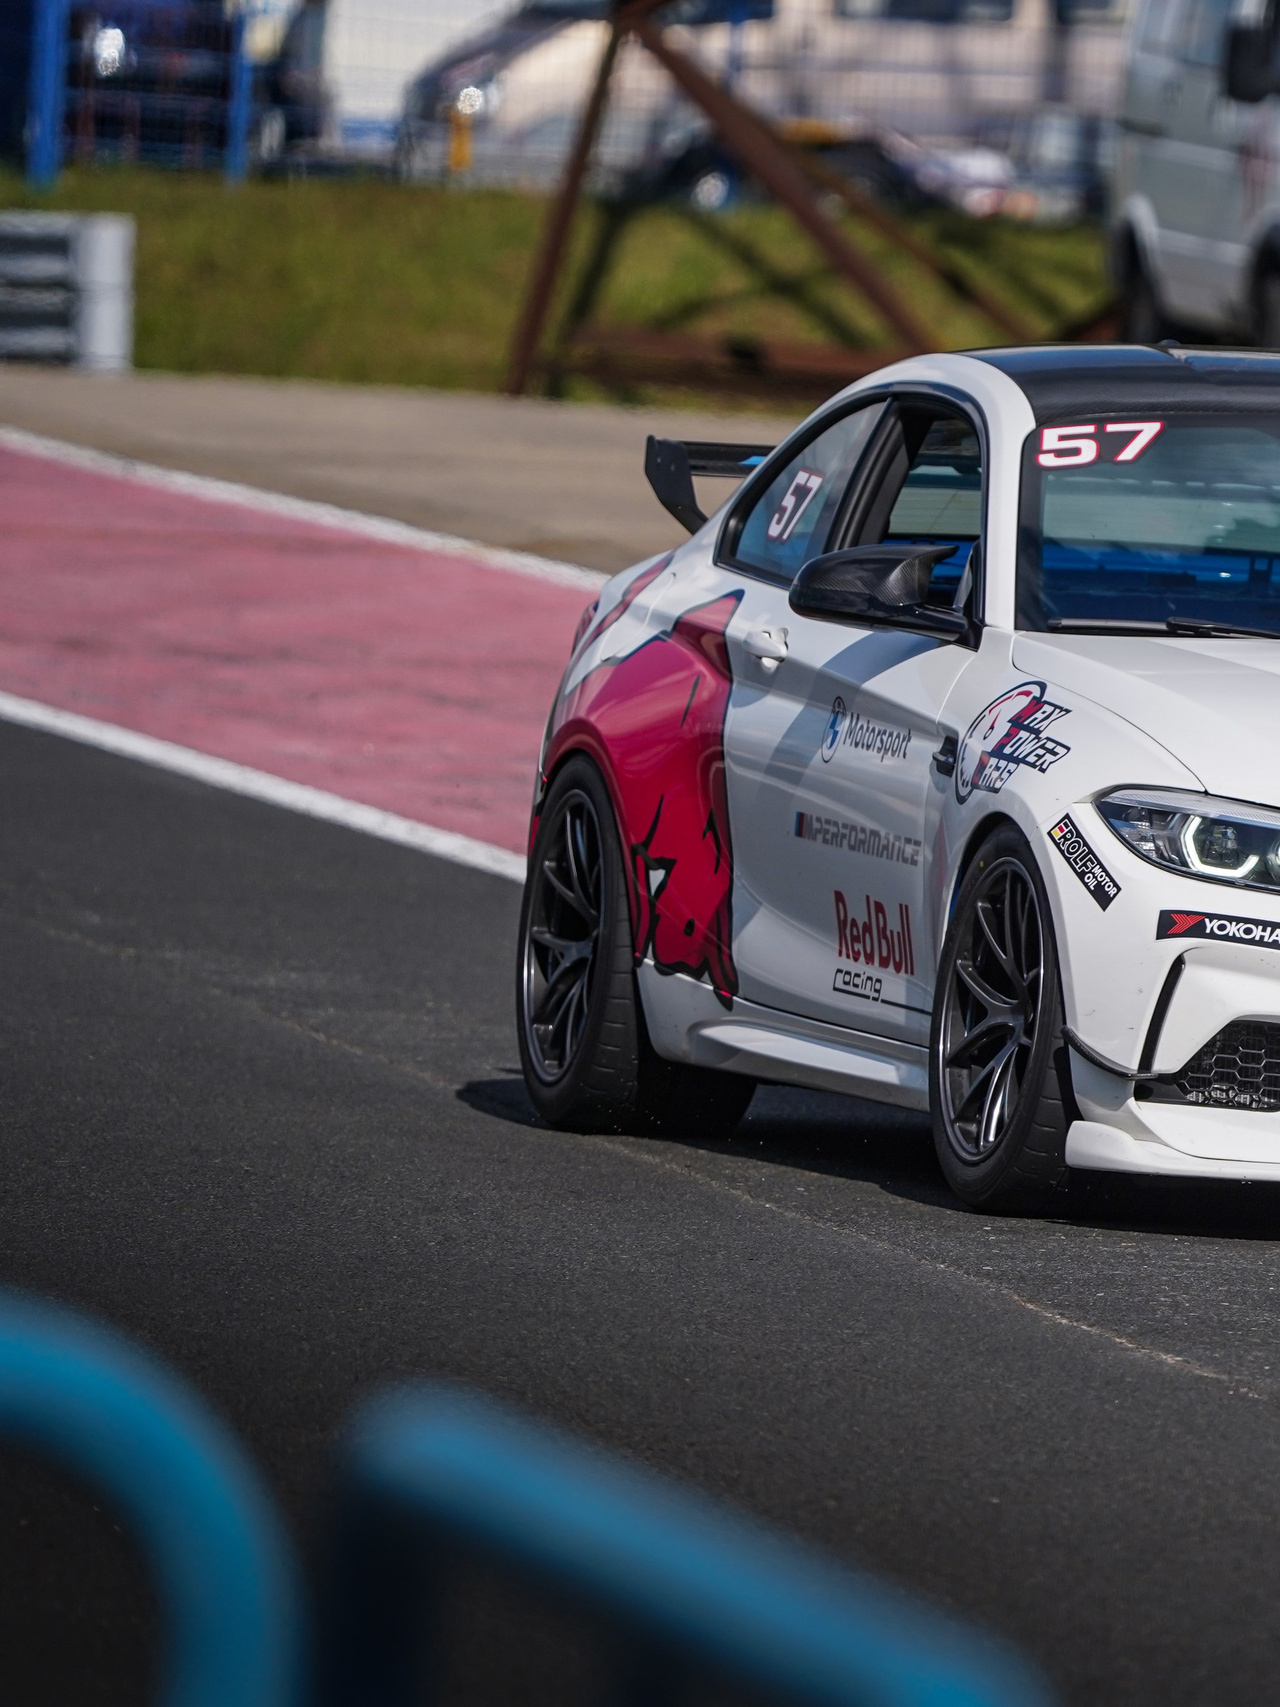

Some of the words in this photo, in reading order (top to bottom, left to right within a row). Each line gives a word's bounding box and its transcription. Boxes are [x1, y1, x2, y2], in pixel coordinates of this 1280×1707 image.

[1036, 421, 1164, 468] 57
[767, 469, 824, 542] 57
[1010, 699, 1069, 729] MAX
[843, 712, 911, 763] Motorsport
[993, 726, 1069, 770] POWER
[972, 753, 1018, 789] CARS
[1054, 822, 1098, 872] ROLF
[1084, 873, 1098, 890] OIL
[1092, 864, 1118, 897] MOTOR
[834, 890, 875, 966] Red
[874, 900, 915, 976] Bull
[833, 968, 883, 1002] racing
